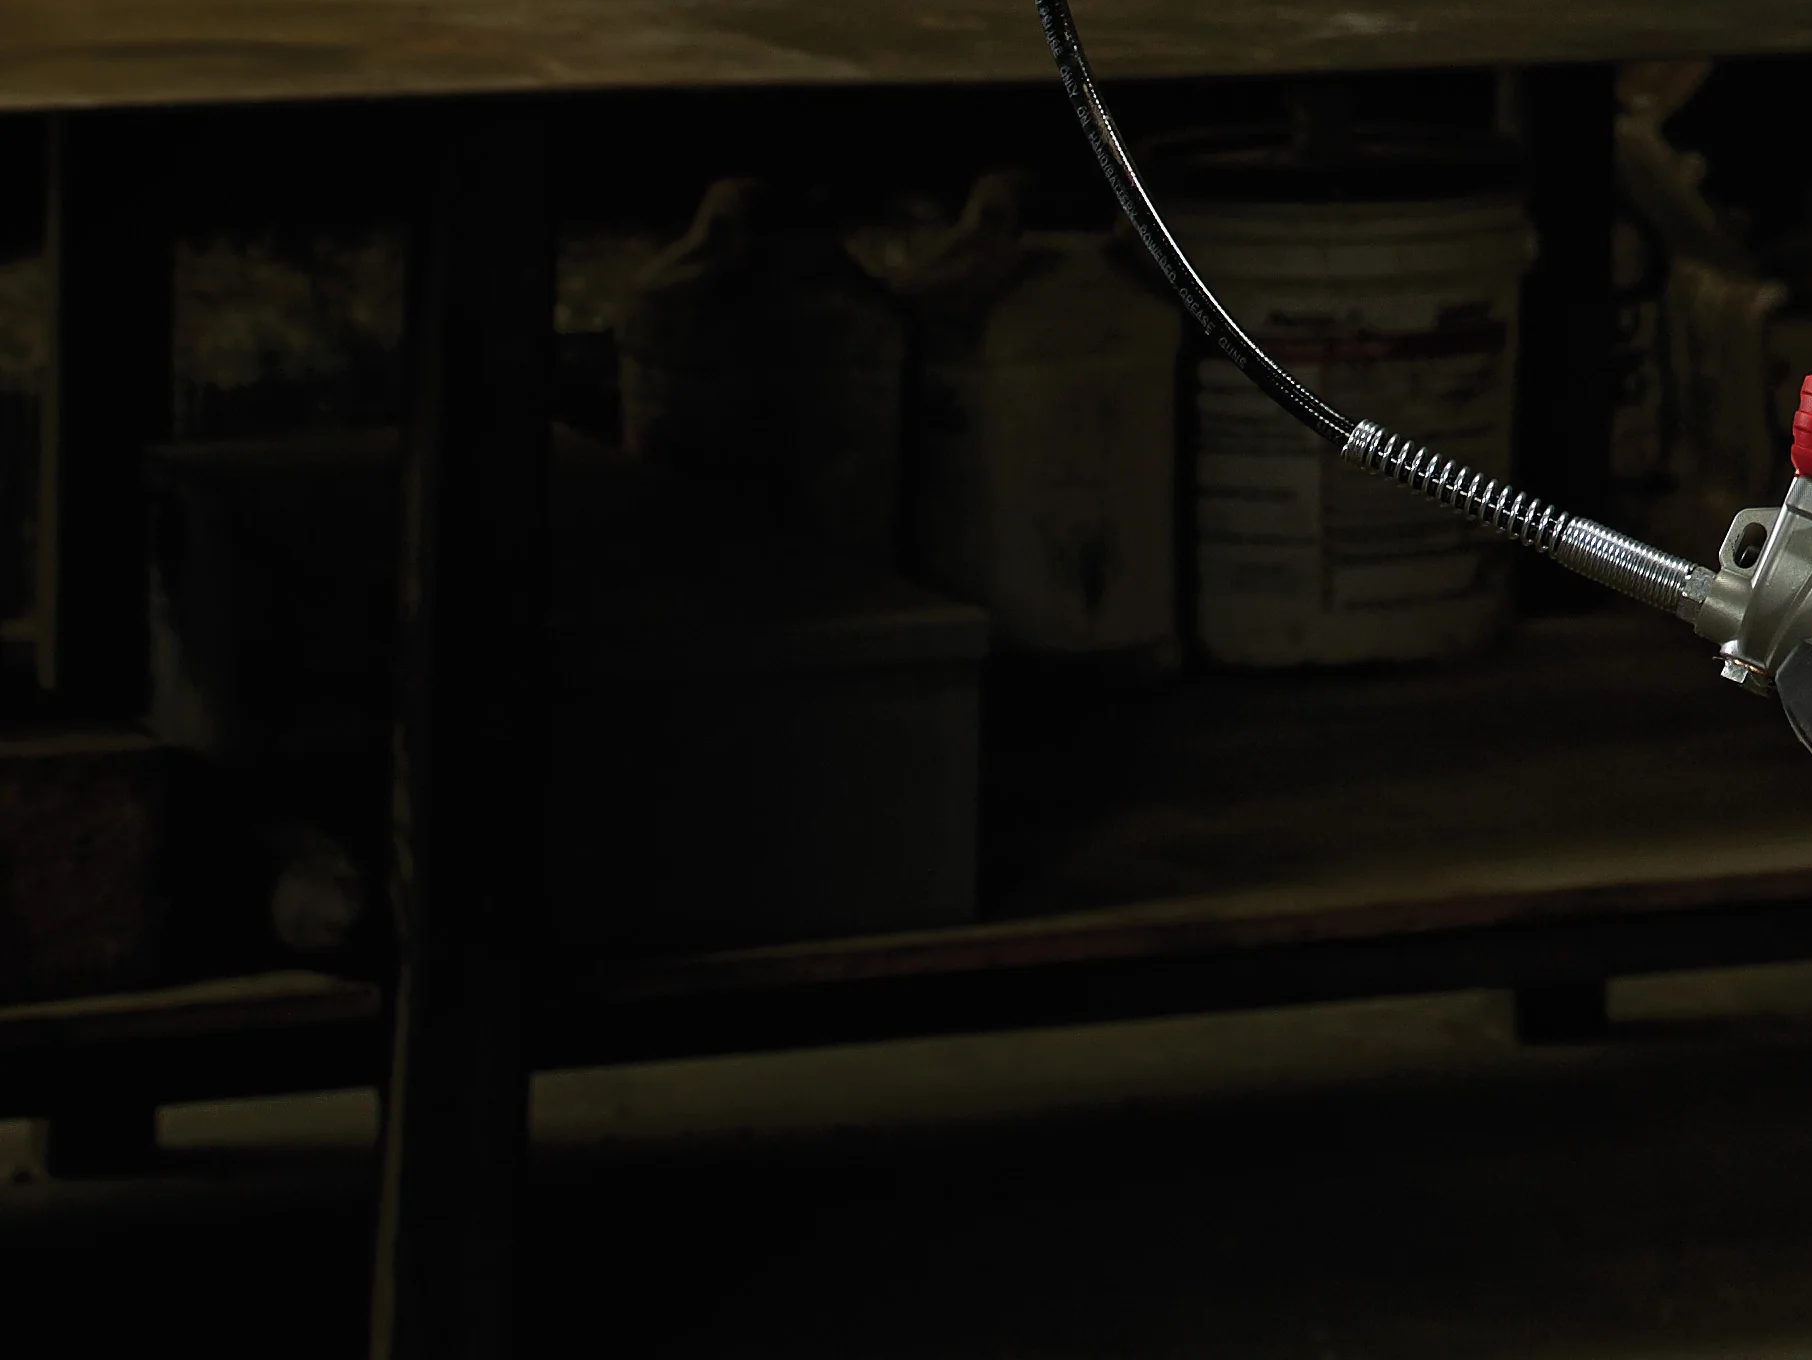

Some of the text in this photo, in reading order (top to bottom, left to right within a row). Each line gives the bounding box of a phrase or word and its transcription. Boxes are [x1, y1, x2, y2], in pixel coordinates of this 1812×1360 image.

[1060, 64, 1080, 98] ONLY
[1076, 104, 1092, 127] ON
[1179, 287, 1216, 334] GREASE
[1217, 336, 1248, 370] GUNS
